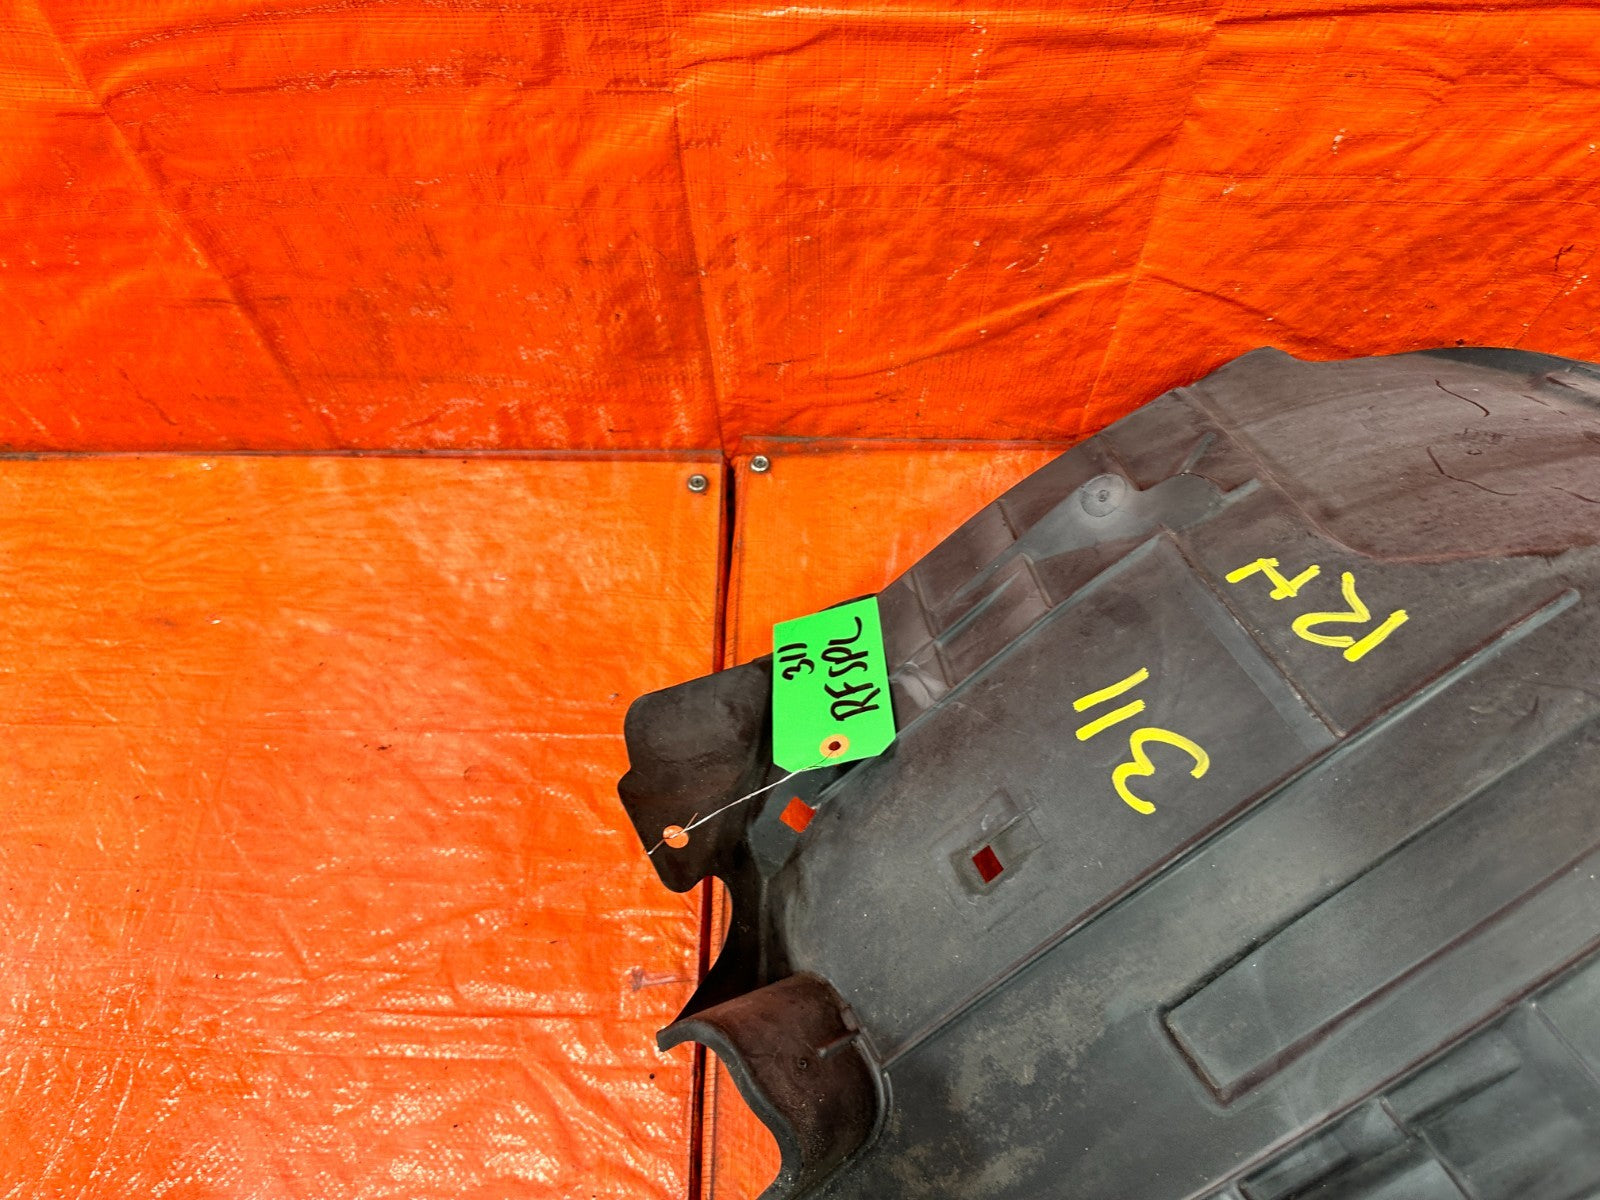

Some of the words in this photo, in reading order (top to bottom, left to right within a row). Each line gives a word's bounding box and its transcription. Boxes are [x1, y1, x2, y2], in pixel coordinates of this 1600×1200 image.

[777, 643, 815, 680] 311
[1225, 558, 1409, 662] RH
[1072, 667, 1211, 815] 311
